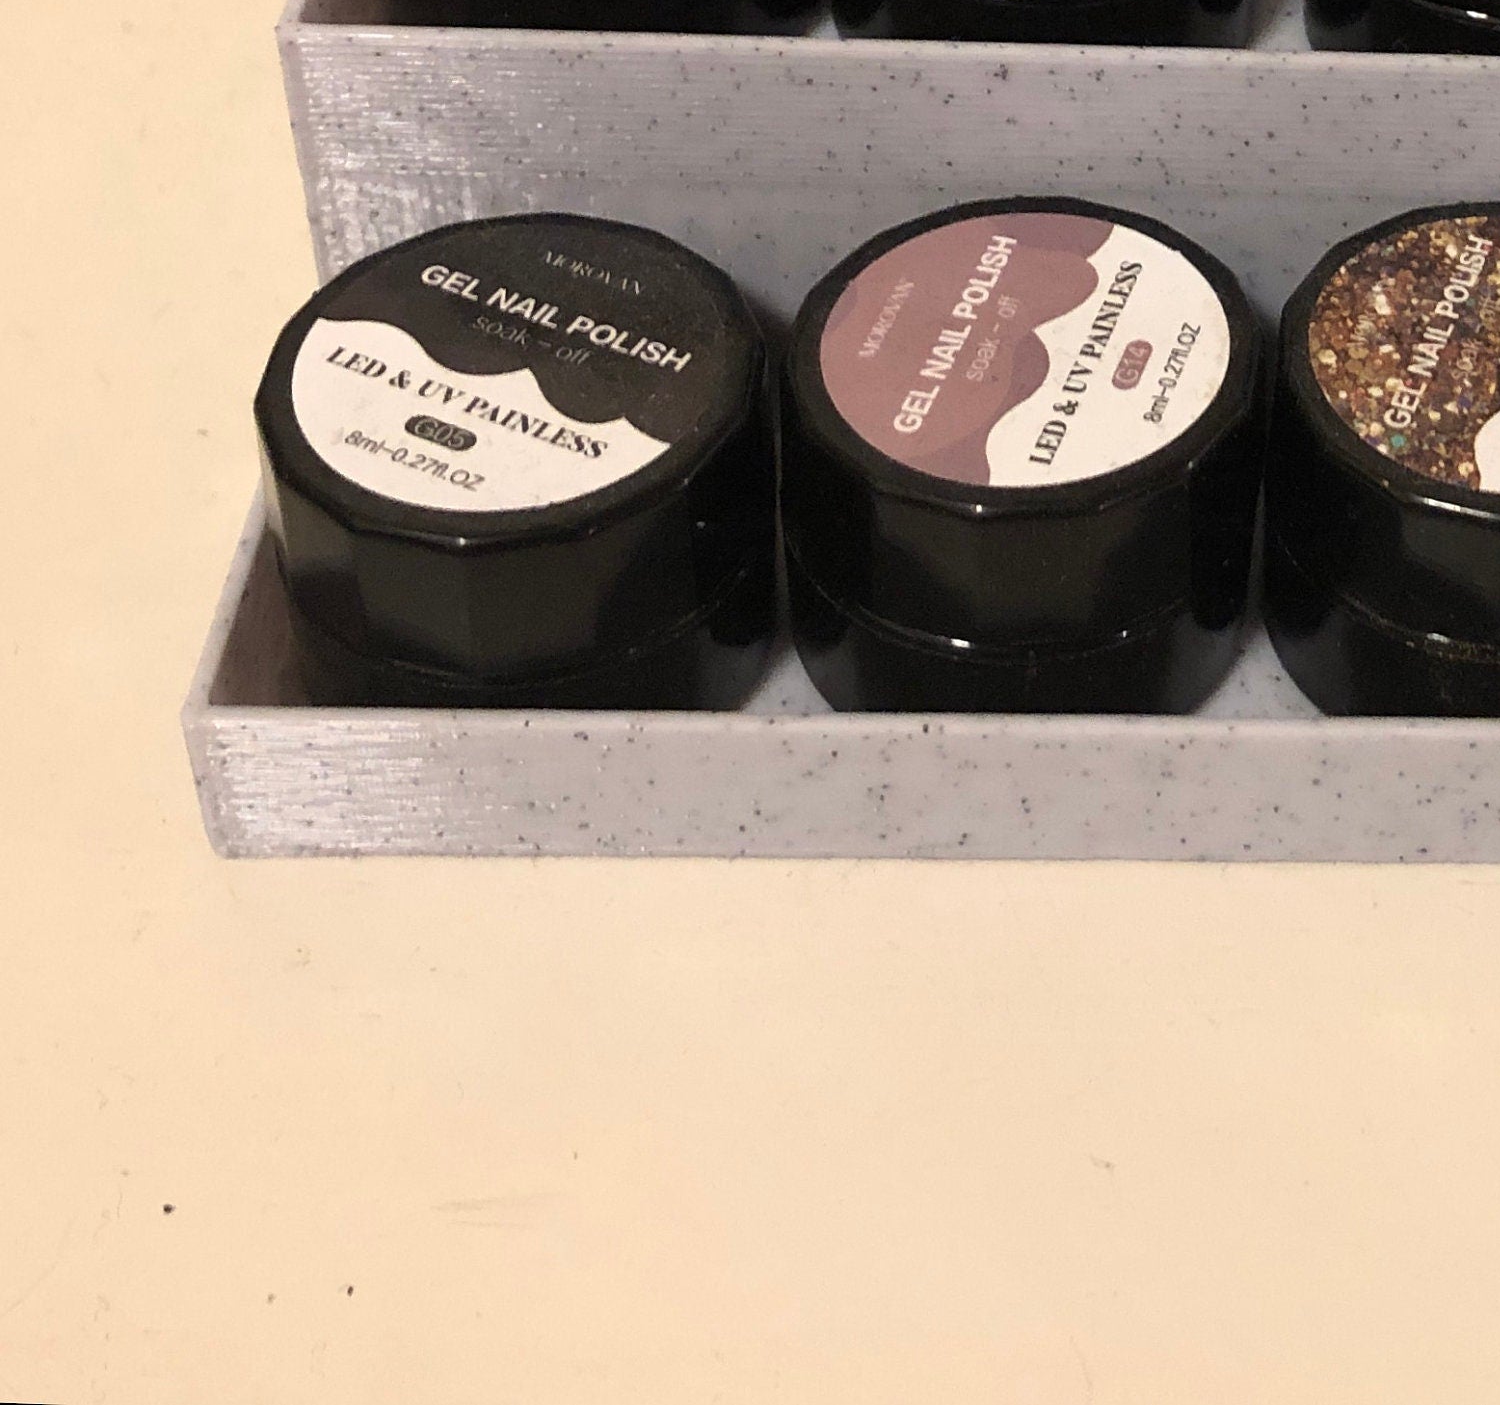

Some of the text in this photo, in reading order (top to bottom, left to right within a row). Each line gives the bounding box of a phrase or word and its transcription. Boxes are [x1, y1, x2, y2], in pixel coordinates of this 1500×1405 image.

[413, 263, 697, 373] GEL NAIL POLISH
[466, 313, 537, 347] soak
[551, 342, 595, 367] off
[889, 232, 1019, 435] GEL NAIL POLISH
[960, 335, 1003, 383] soak
[991, 293, 1024, 319] off
[1027, 259, 1145, 466] LED & UV PAINLESS
[1113, 344, 1151, 385] G14
[1380, 232, 1496, 431] GEL NAIL POLISH
[322, 346, 612, 461] LED & UV PAINLESS
[407, 416, 473, 449] G05
